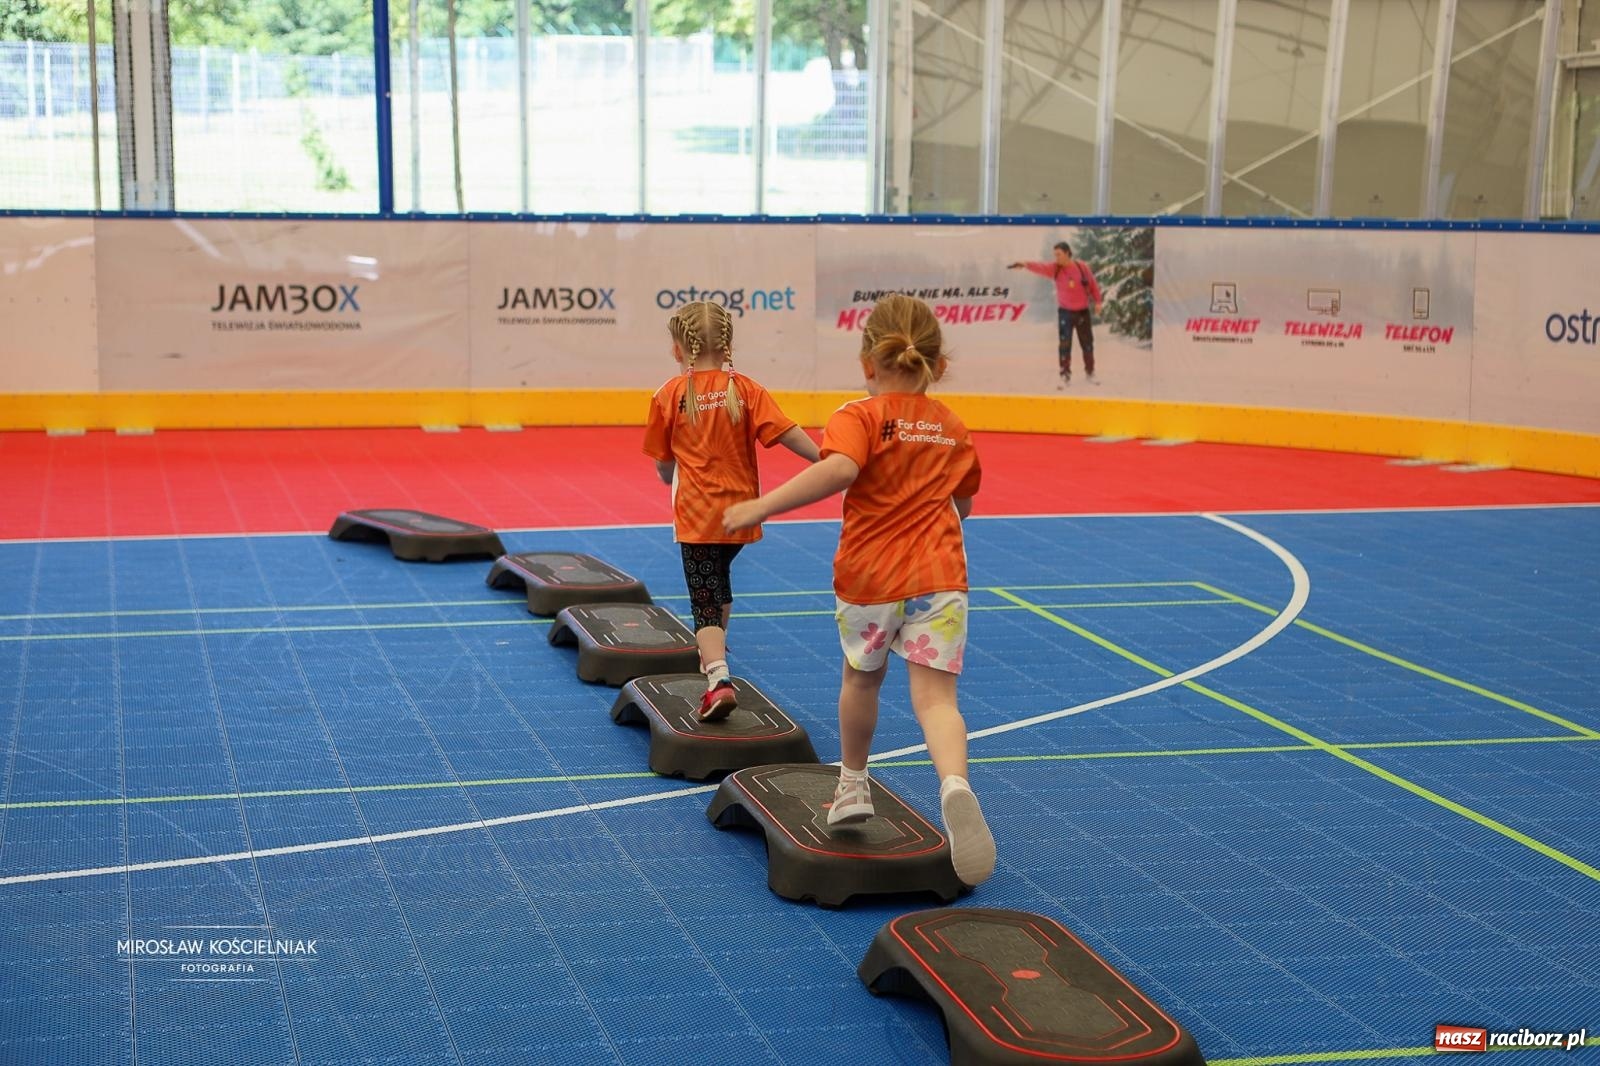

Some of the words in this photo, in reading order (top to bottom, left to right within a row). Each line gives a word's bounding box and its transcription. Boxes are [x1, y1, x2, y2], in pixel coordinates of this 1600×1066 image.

[853, 287, 917, 303] BUNW
[919, 287, 940, 299] NIE
[967, 286, 989, 297] ALE
[934, 303, 1026, 325] PAKIETY
[1186, 317, 1260, 334] INTERNET
[1284, 321, 1363, 340] TELEWIZJA
[1385, 324, 1454, 345] TELEFON
[697, 398, 745, 411] onnects
[897, 419, 914, 430] For
[916, 420, 942, 432] Good
[898, 431, 956, 447] Connections
